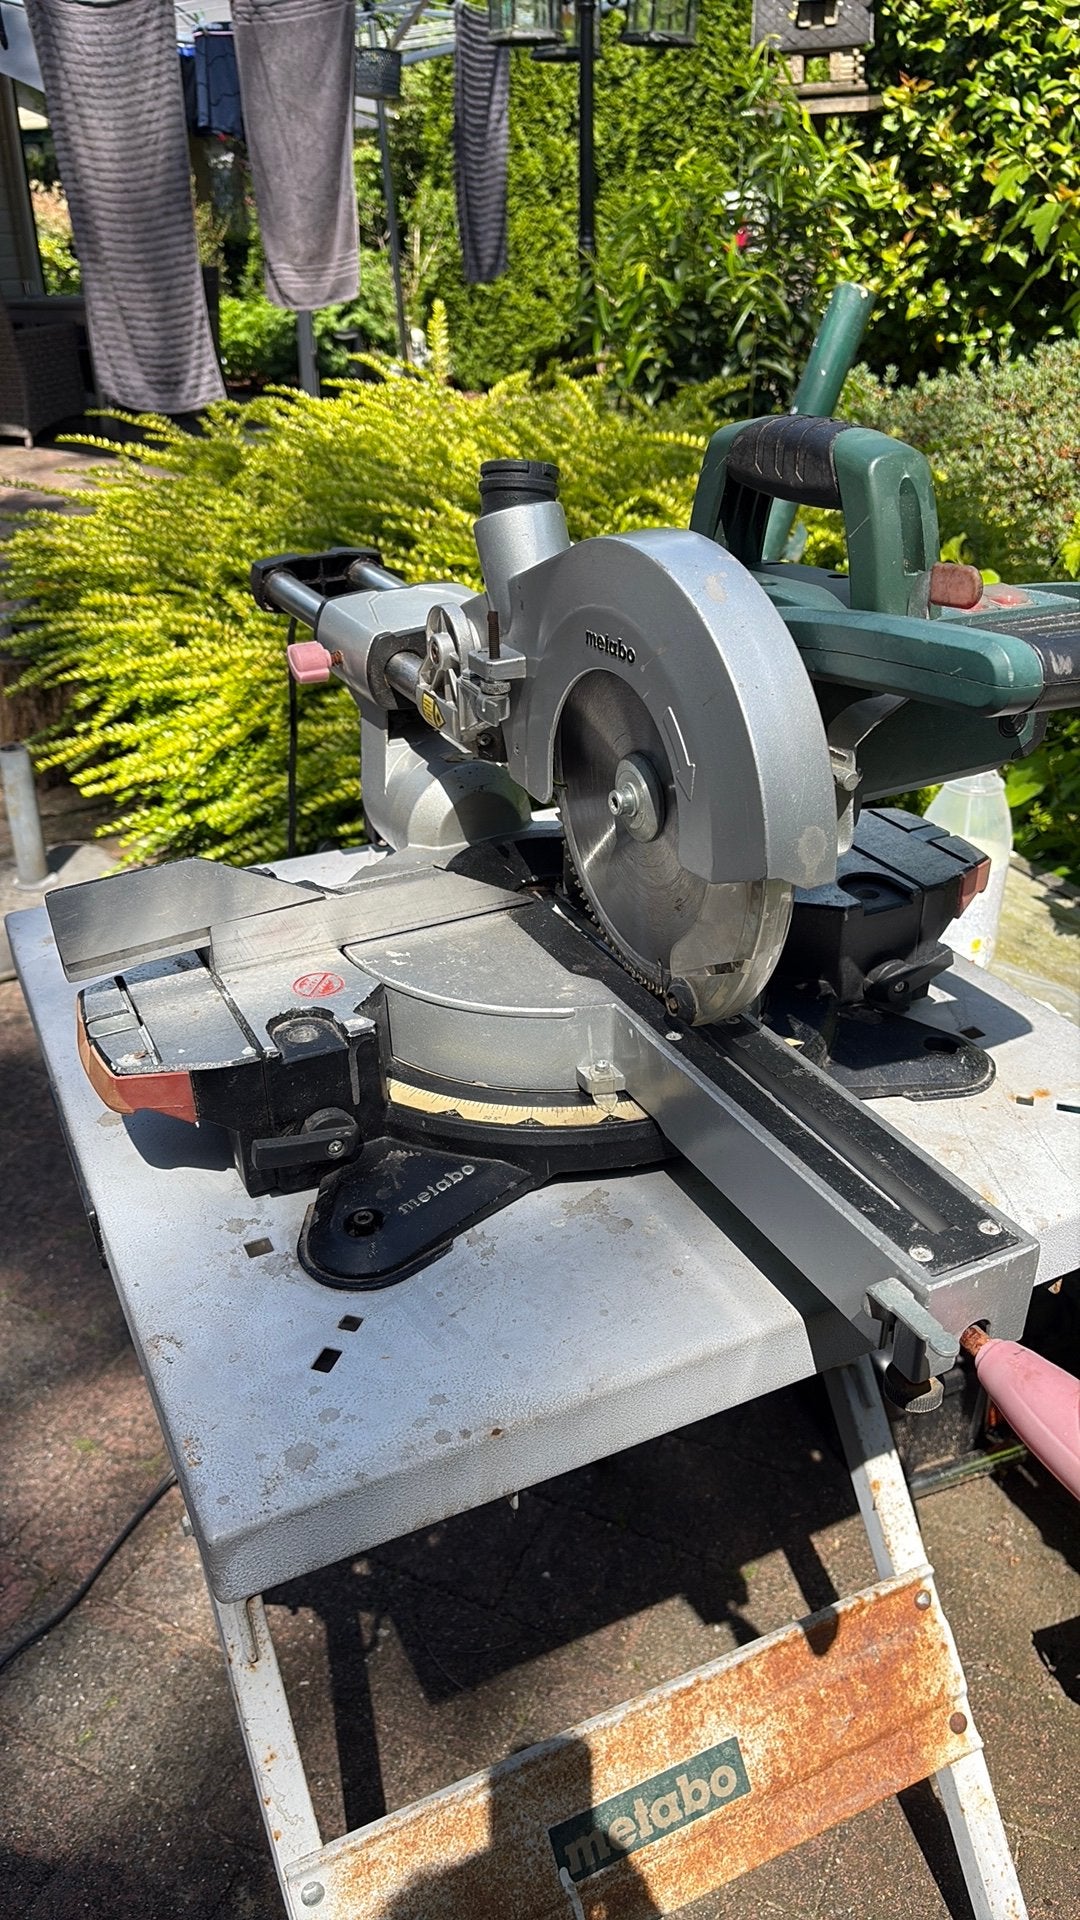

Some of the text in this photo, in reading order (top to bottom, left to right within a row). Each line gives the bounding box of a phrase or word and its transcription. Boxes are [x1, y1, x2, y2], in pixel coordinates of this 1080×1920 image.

[585, 629, 636, 664] metabo
[398, 1164, 475, 1215] metabo
[564, 1765, 738, 1875] metabo
